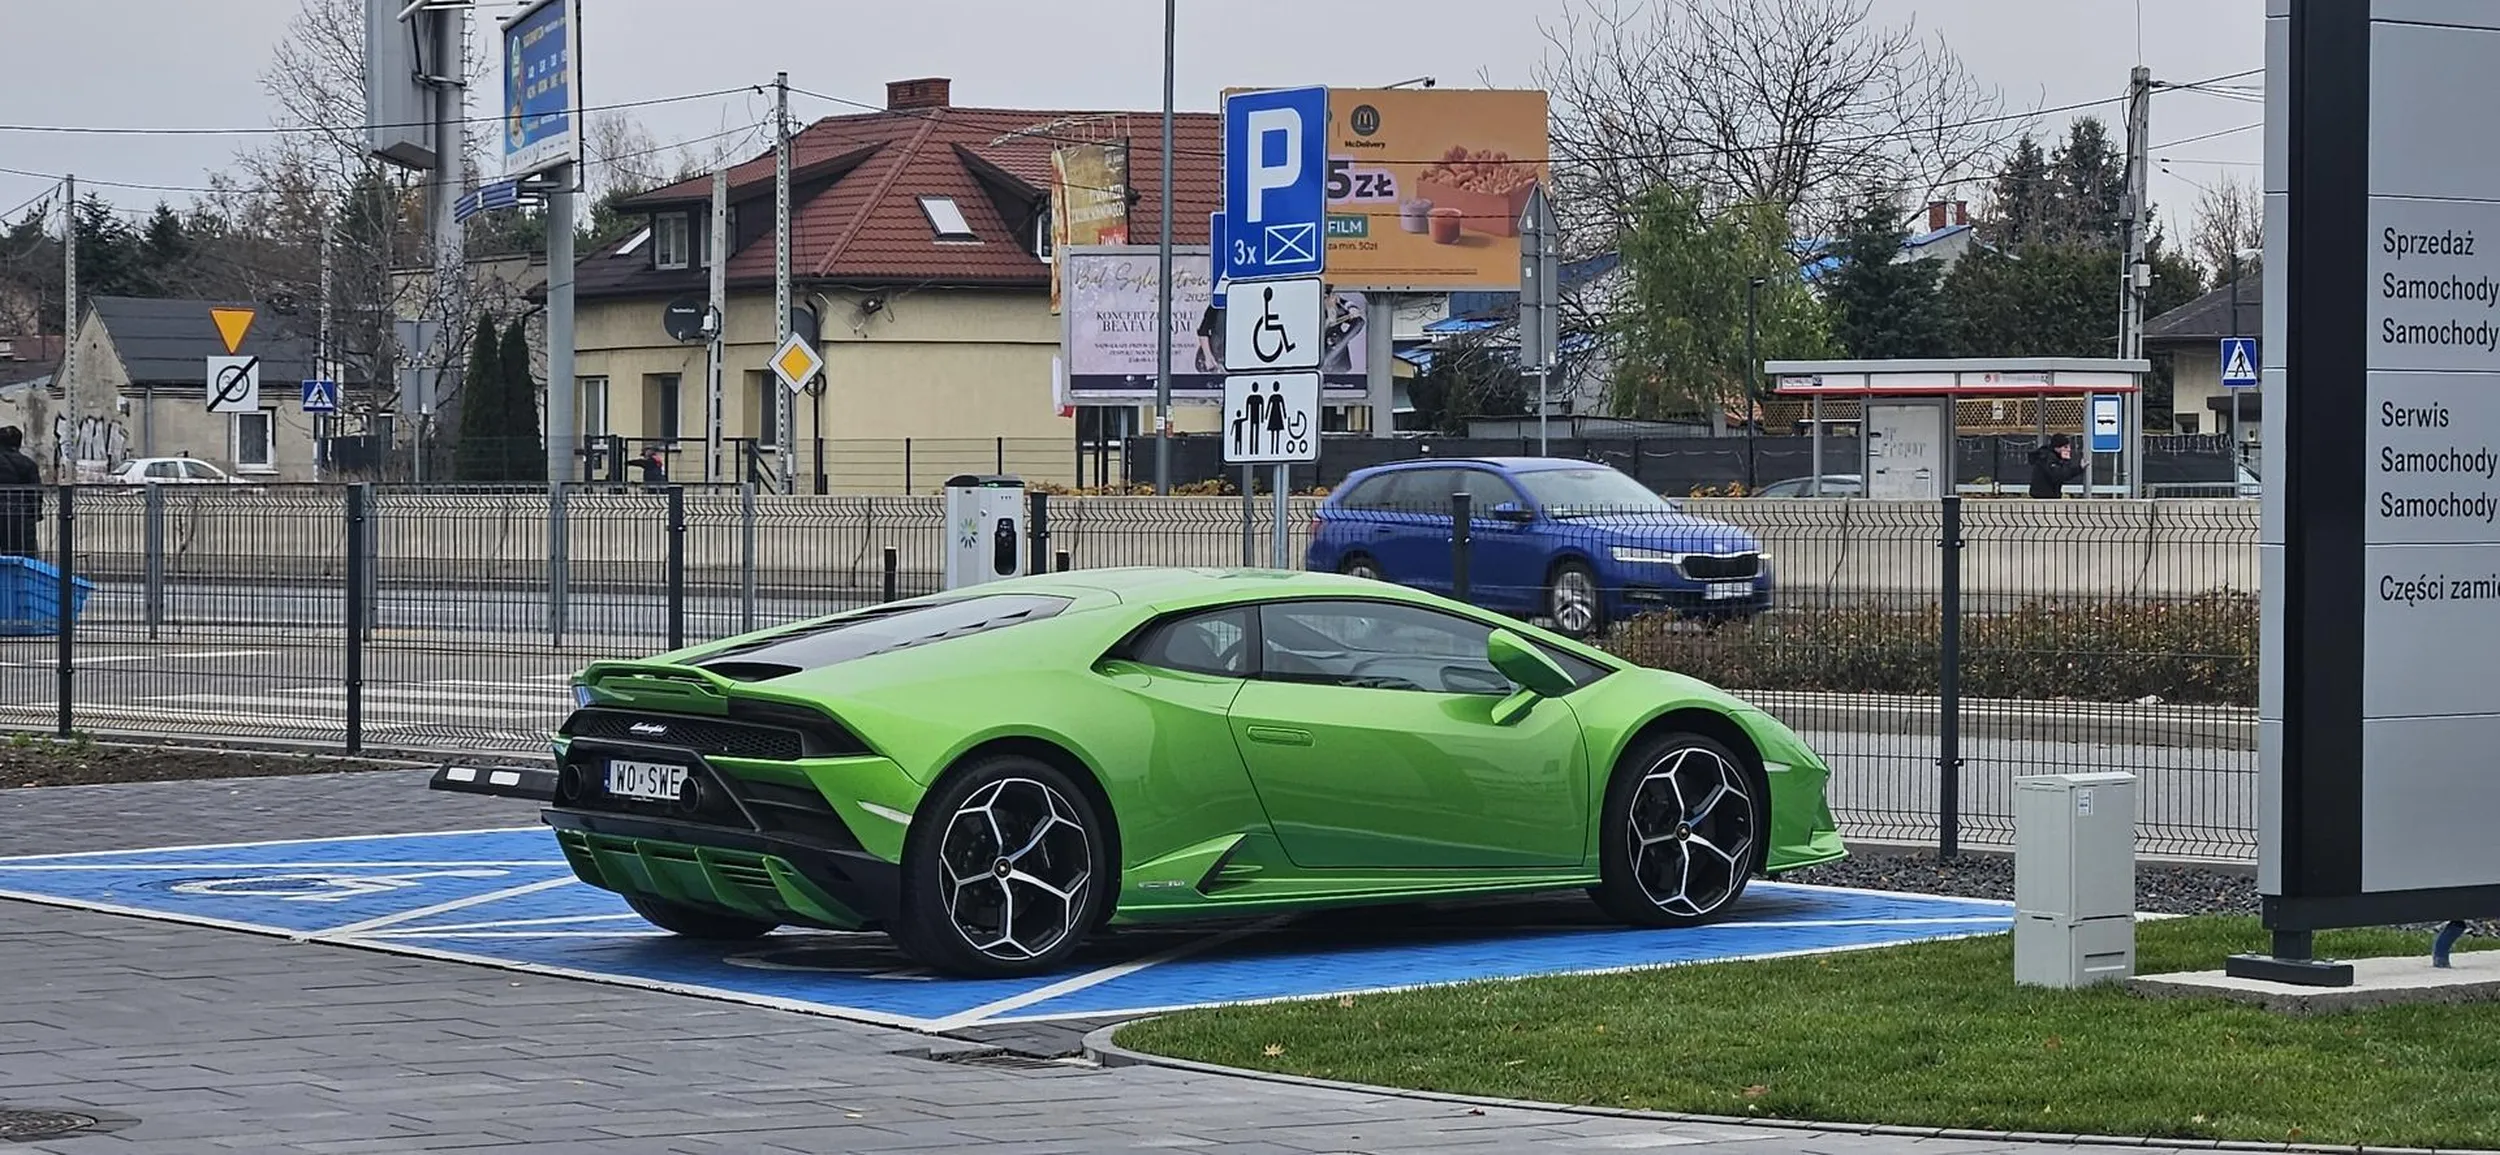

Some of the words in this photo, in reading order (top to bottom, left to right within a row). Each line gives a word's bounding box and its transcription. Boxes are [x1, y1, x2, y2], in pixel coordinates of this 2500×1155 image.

[1247, 107, 1302, 223] P
[1233, 239, 1257, 265] 3x
[2383, 226, 2475, 261] Sprzedaż
[2382, 271, 2500, 309] Samochody
[1096, 311, 1147, 321] KONCERT
[1103, 320, 1145, 332] BEATA
[2382, 317, 2500, 353] Samochody
[2381, 400, 2450, 428] Serwis
[2380, 446, 2499, 480] Samochody
[2380, 491, 2499, 524] Samochody
[2380, 573, 2444, 608] Części
[2450, 573, 2500, 600] zami
[616, 763, 636, 792] WO
[647, 766, 681, 797] SWE
